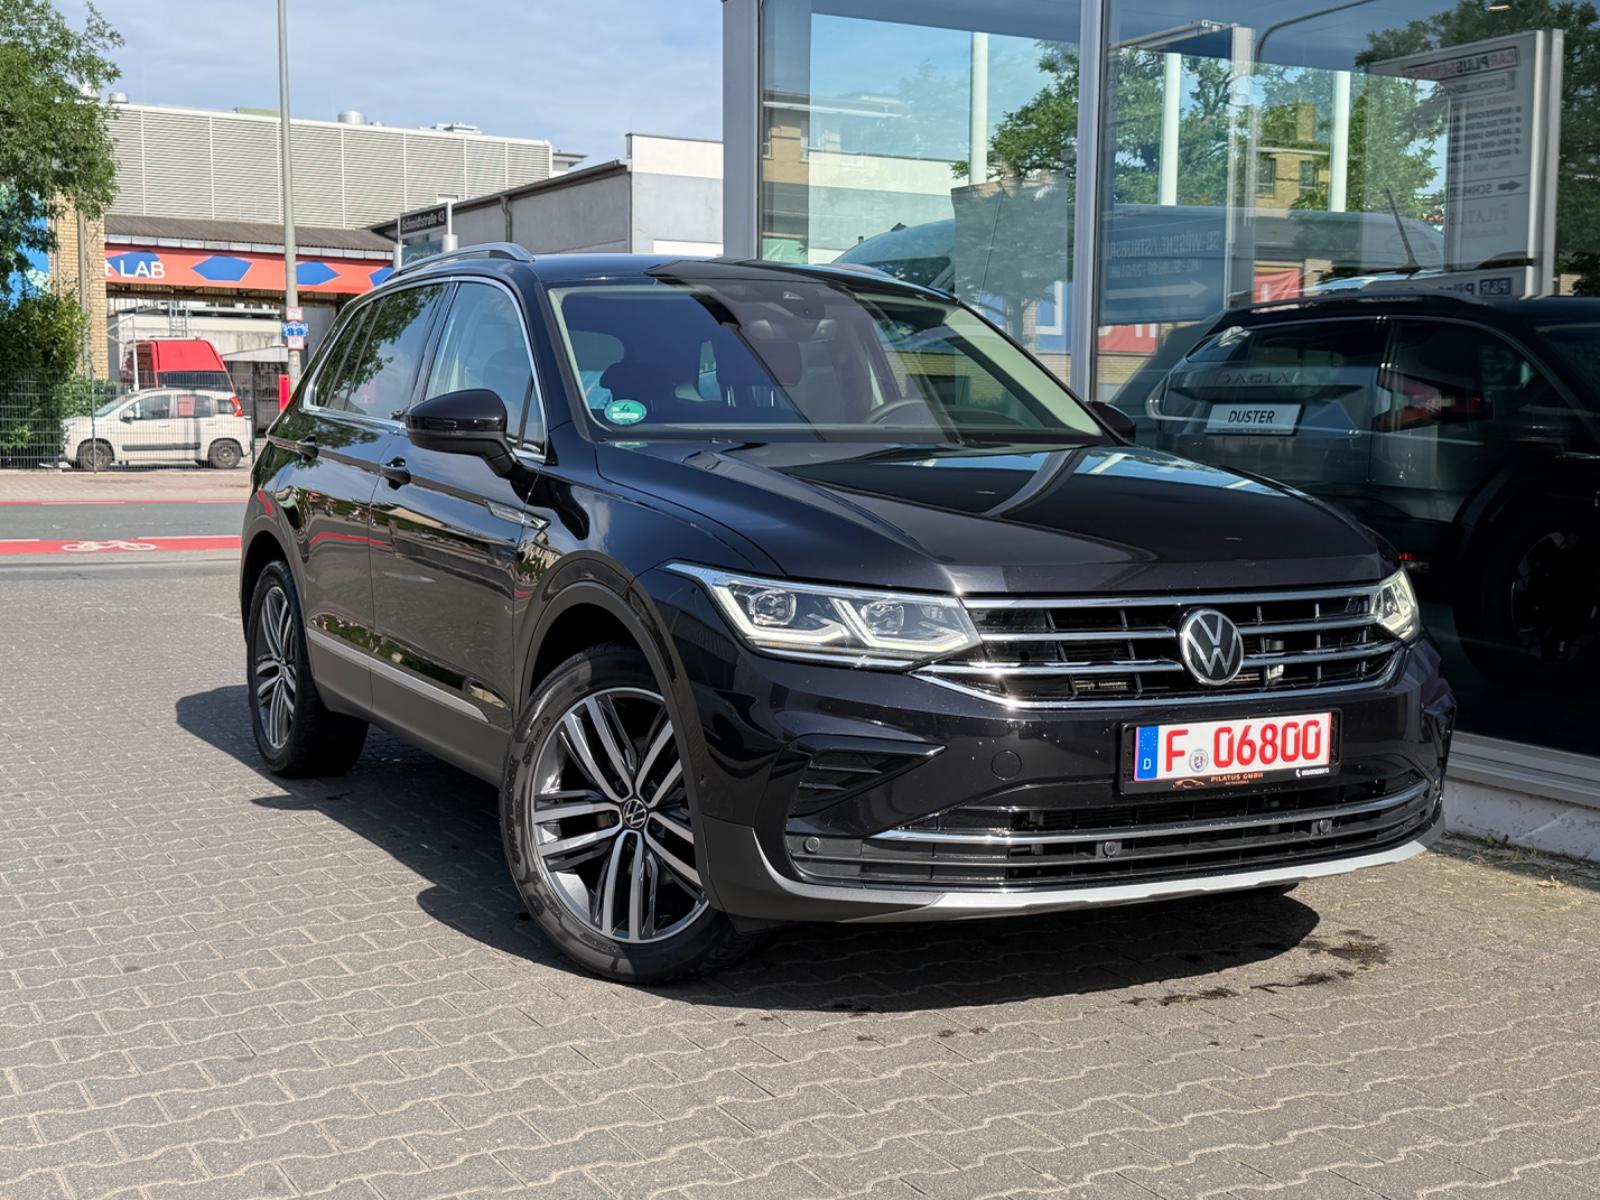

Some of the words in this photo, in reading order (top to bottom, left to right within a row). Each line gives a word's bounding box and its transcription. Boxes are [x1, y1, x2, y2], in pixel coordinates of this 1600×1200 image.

[119, 259, 165, 279] LAB
[1228, 410, 1275, 424] DUSTER
[1165, 729, 1188, 773] F
[1213, 719, 1321, 768] 06800
[1143, 758, 1152, 770] D
[1210, 773, 1241, 783] PILATUS
